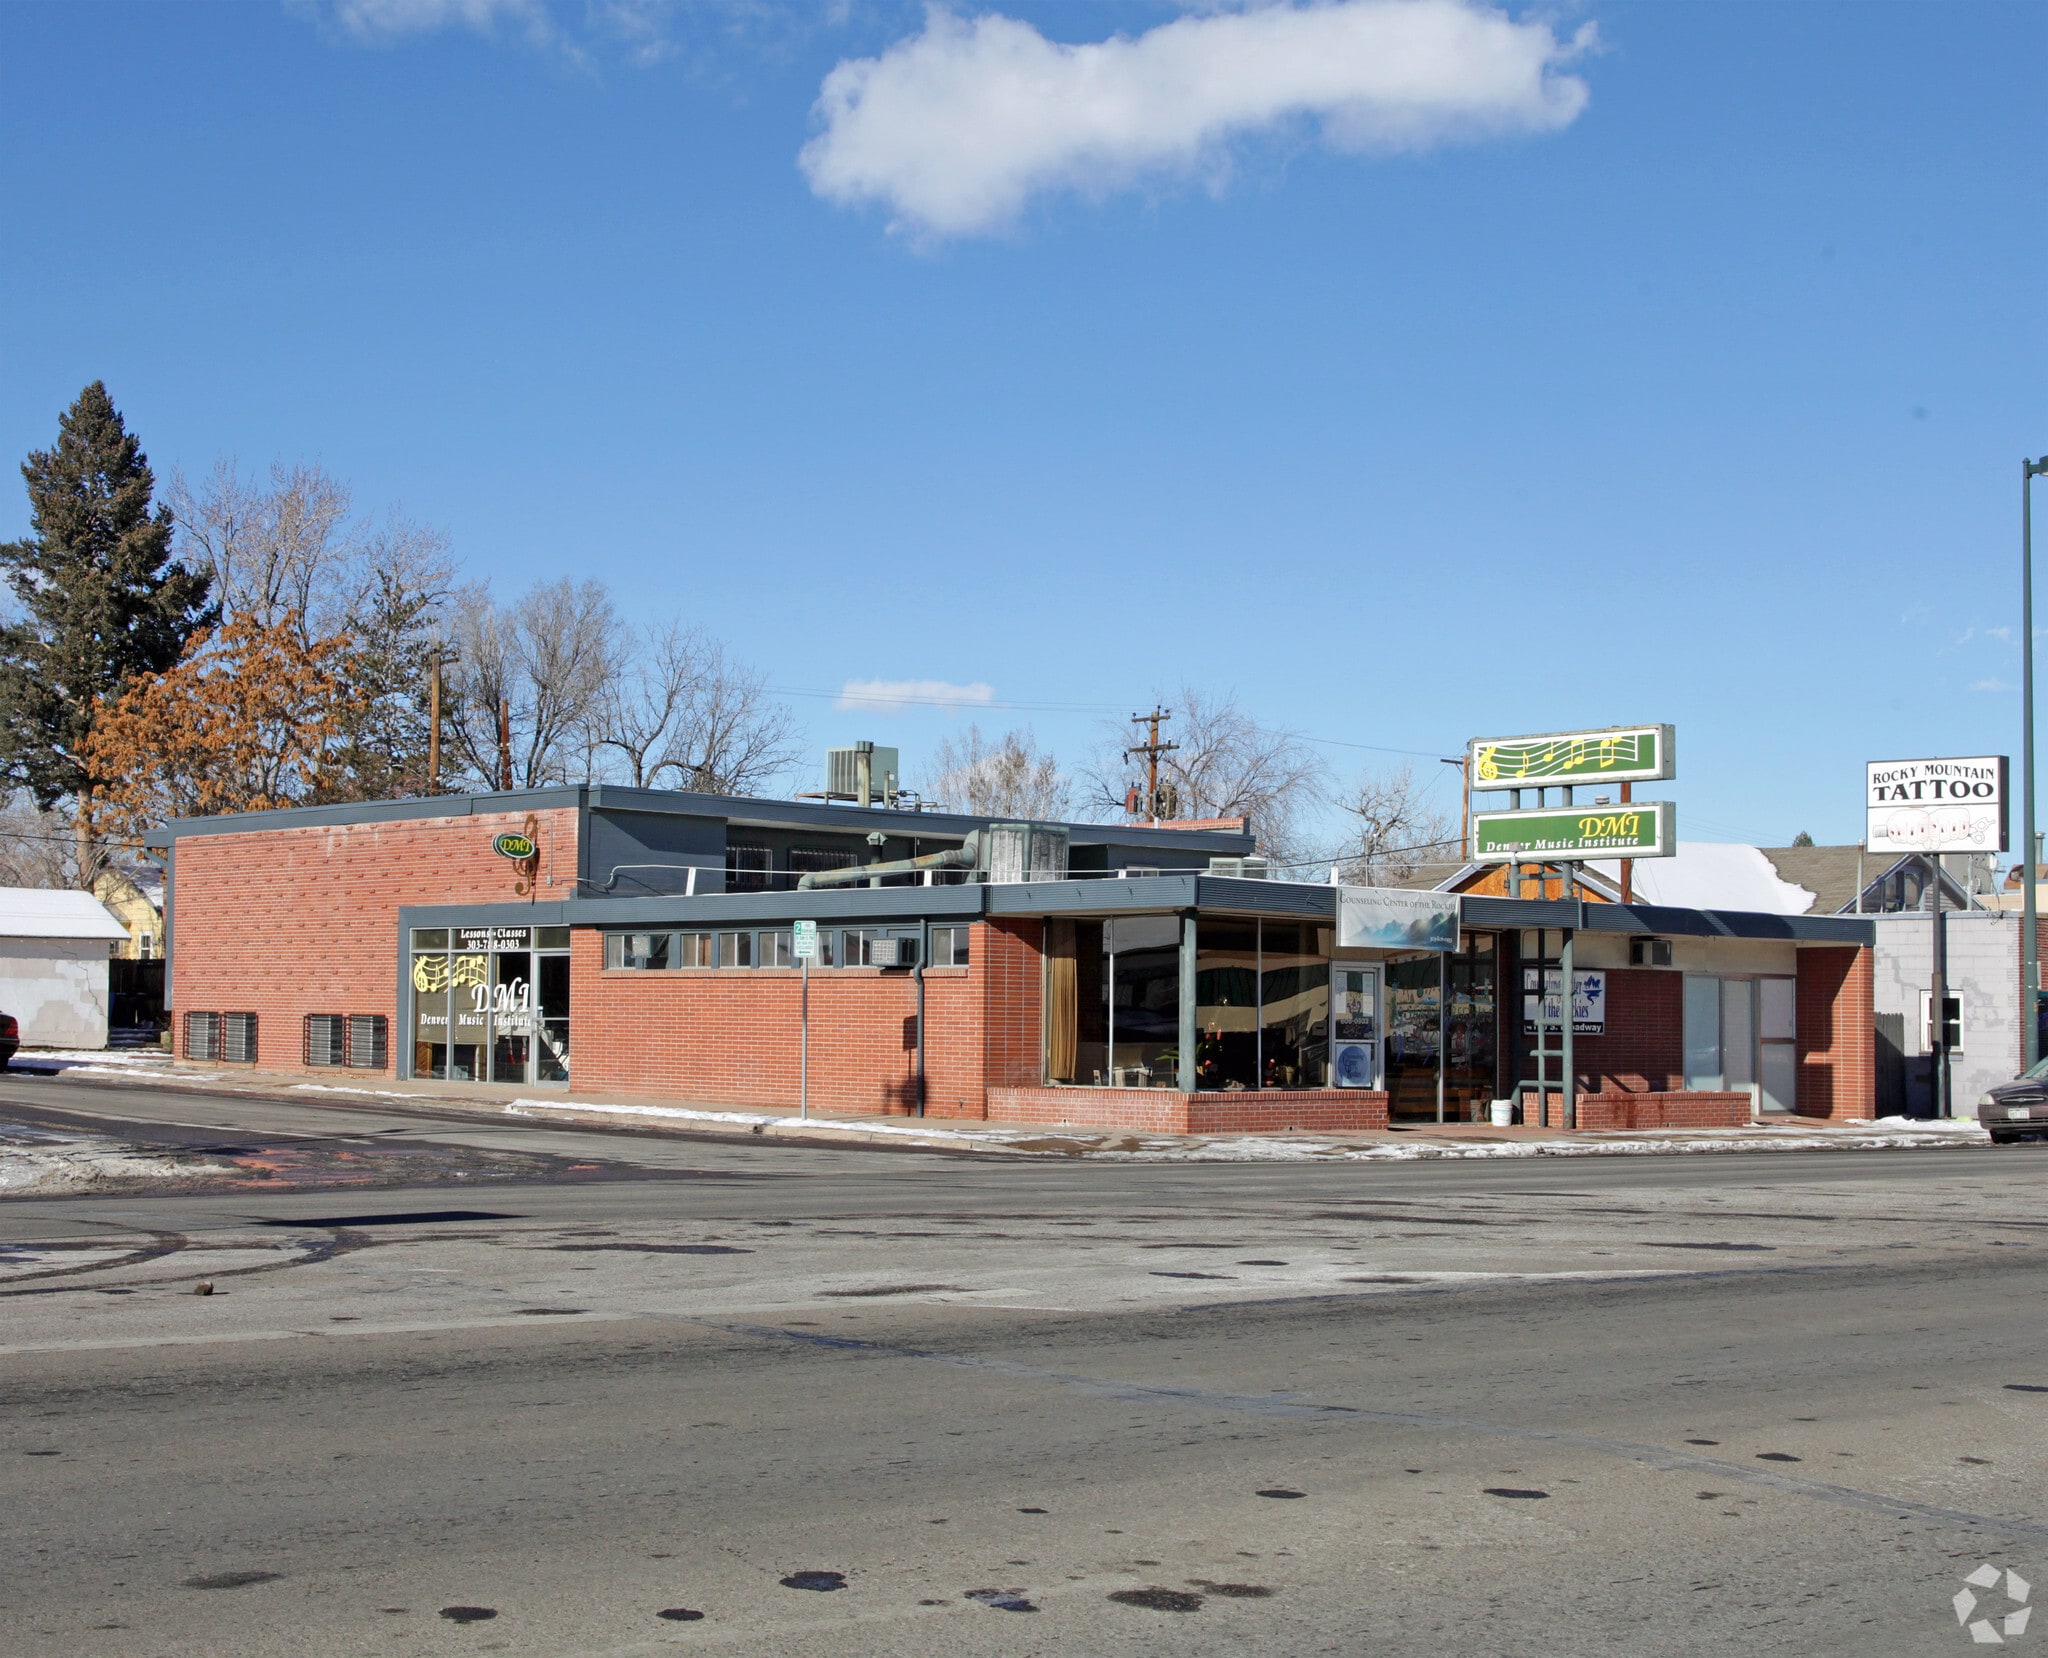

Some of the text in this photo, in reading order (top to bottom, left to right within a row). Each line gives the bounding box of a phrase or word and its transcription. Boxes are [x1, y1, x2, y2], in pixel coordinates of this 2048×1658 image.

[1873, 764, 1994, 784] ROCKY MOUNTAIN
[1873, 779, 1994, 801] TATTOO
[1579, 812, 1640, 838] DMI
[501, 838, 530, 852] DMI
[1535, 838, 1574, 849] Music
[1578, 836, 1639, 848] Institute
[1383, 897, 1408, 908] CENTER
[497, 928, 527, 938] Classes
[471, 977, 530, 1013] DMI
[458, 1013, 484, 1025] Music
